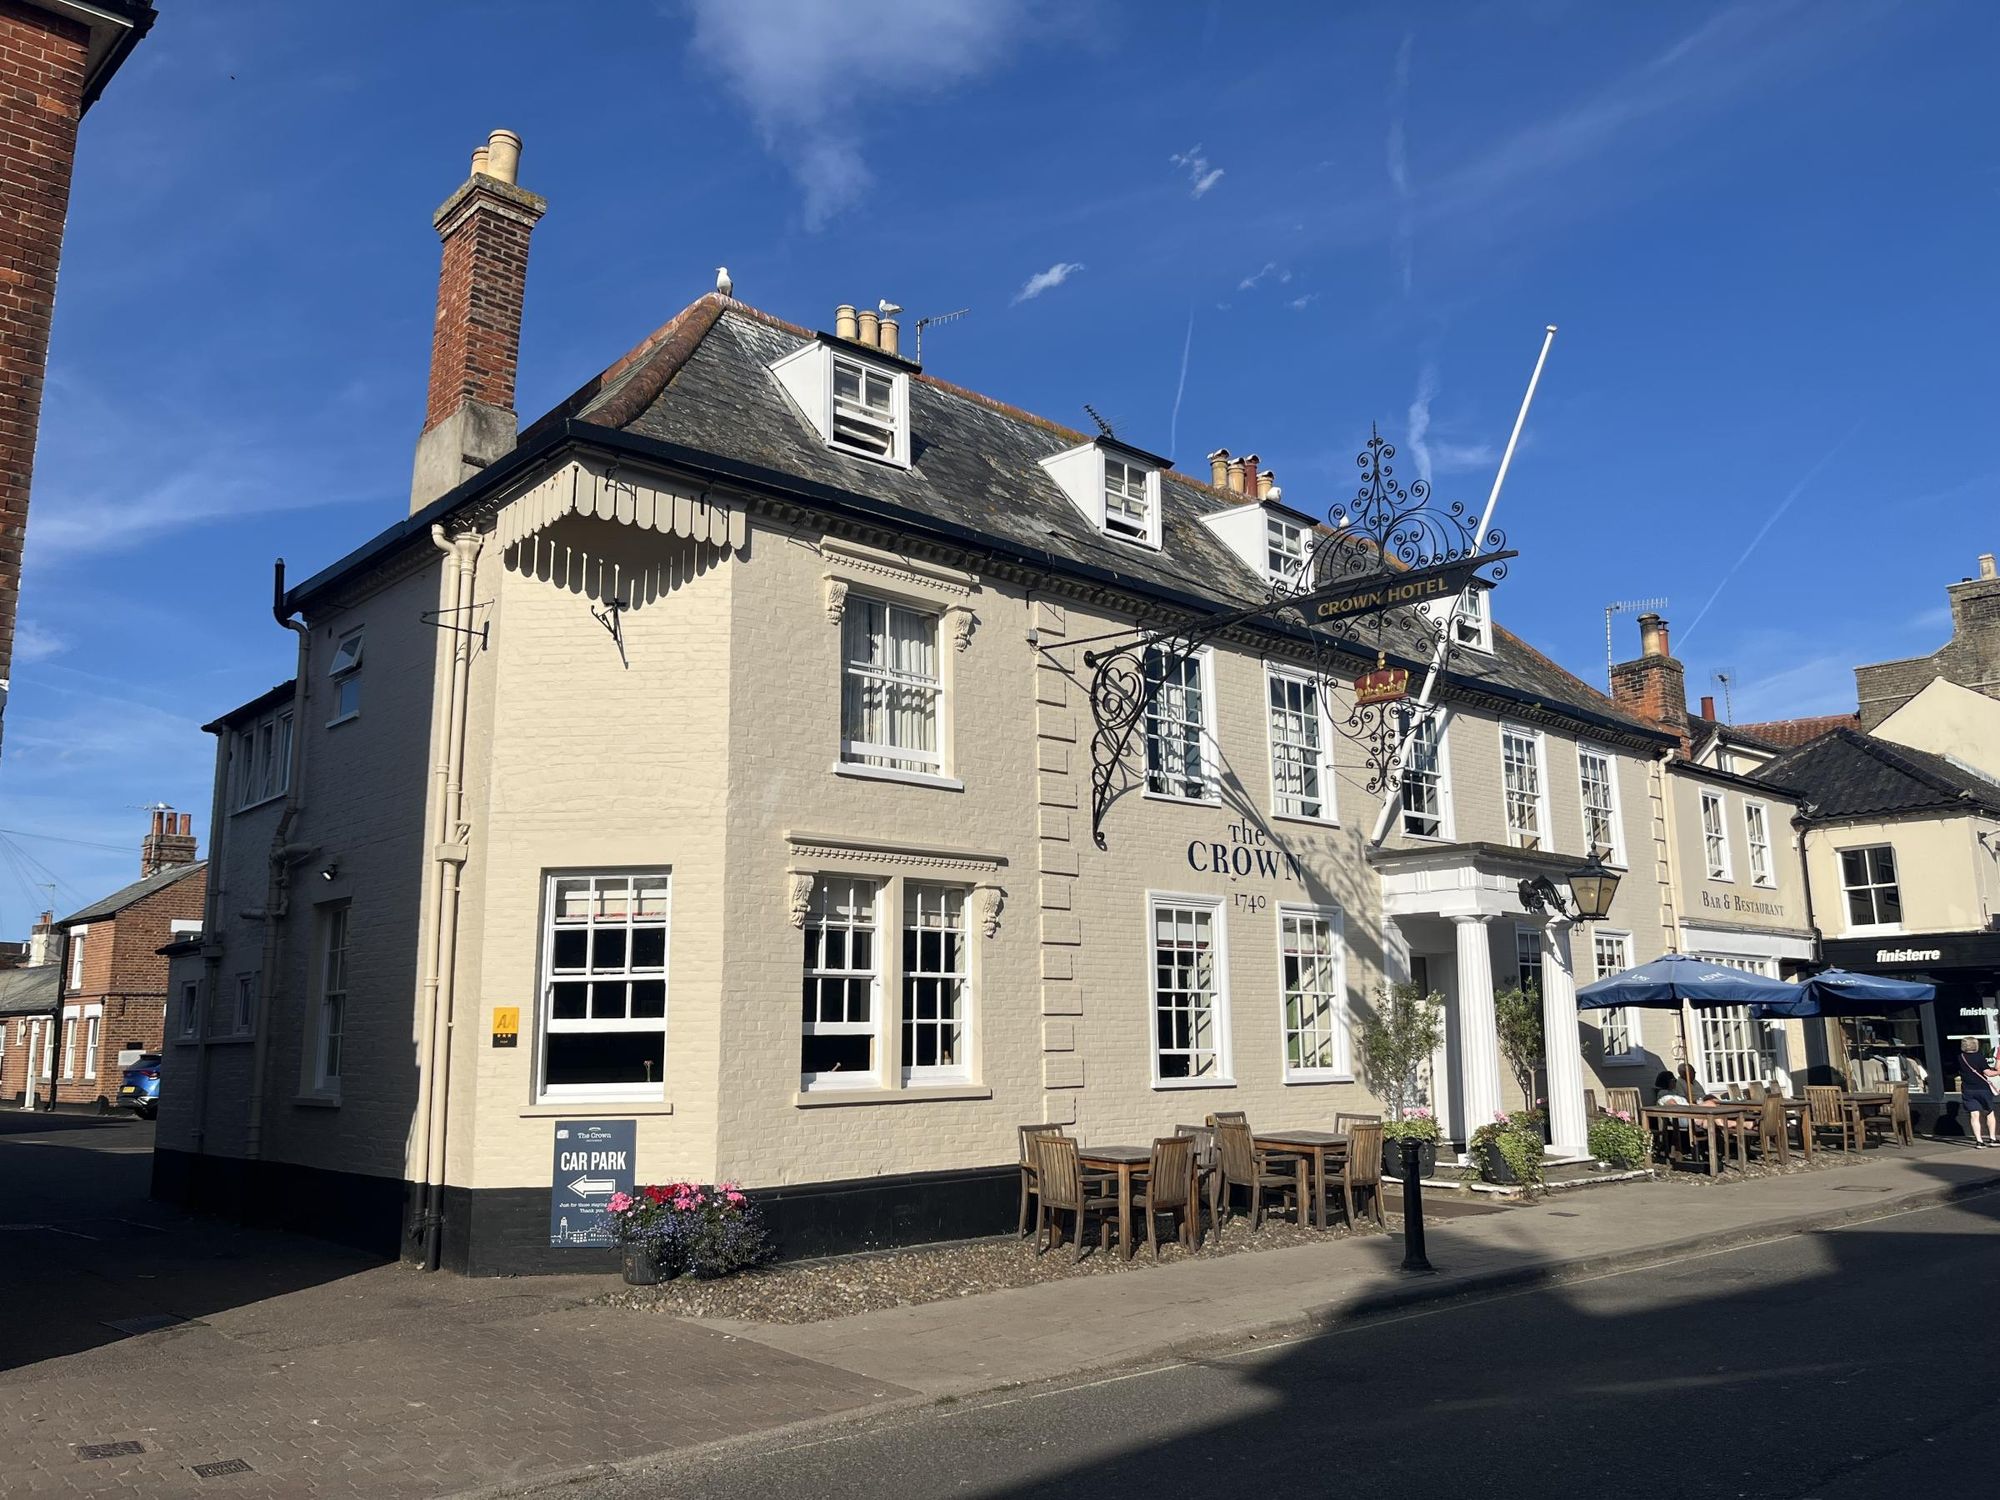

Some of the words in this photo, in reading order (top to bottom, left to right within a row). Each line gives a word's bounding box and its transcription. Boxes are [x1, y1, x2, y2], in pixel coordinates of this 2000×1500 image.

[1317, 592, 1381, 617] CROWN
[1388, 577, 1448, 602] HOTEL
[1187, 840, 1302, 882] CROWN
[1234, 893, 1266, 914] 1740
[1723, 893, 1731, 910] &
[1876, 948, 1941, 963] finisterre
[560, 1151, 588, 1171] CAR
[590, 1150, 627, 1170] PARK
